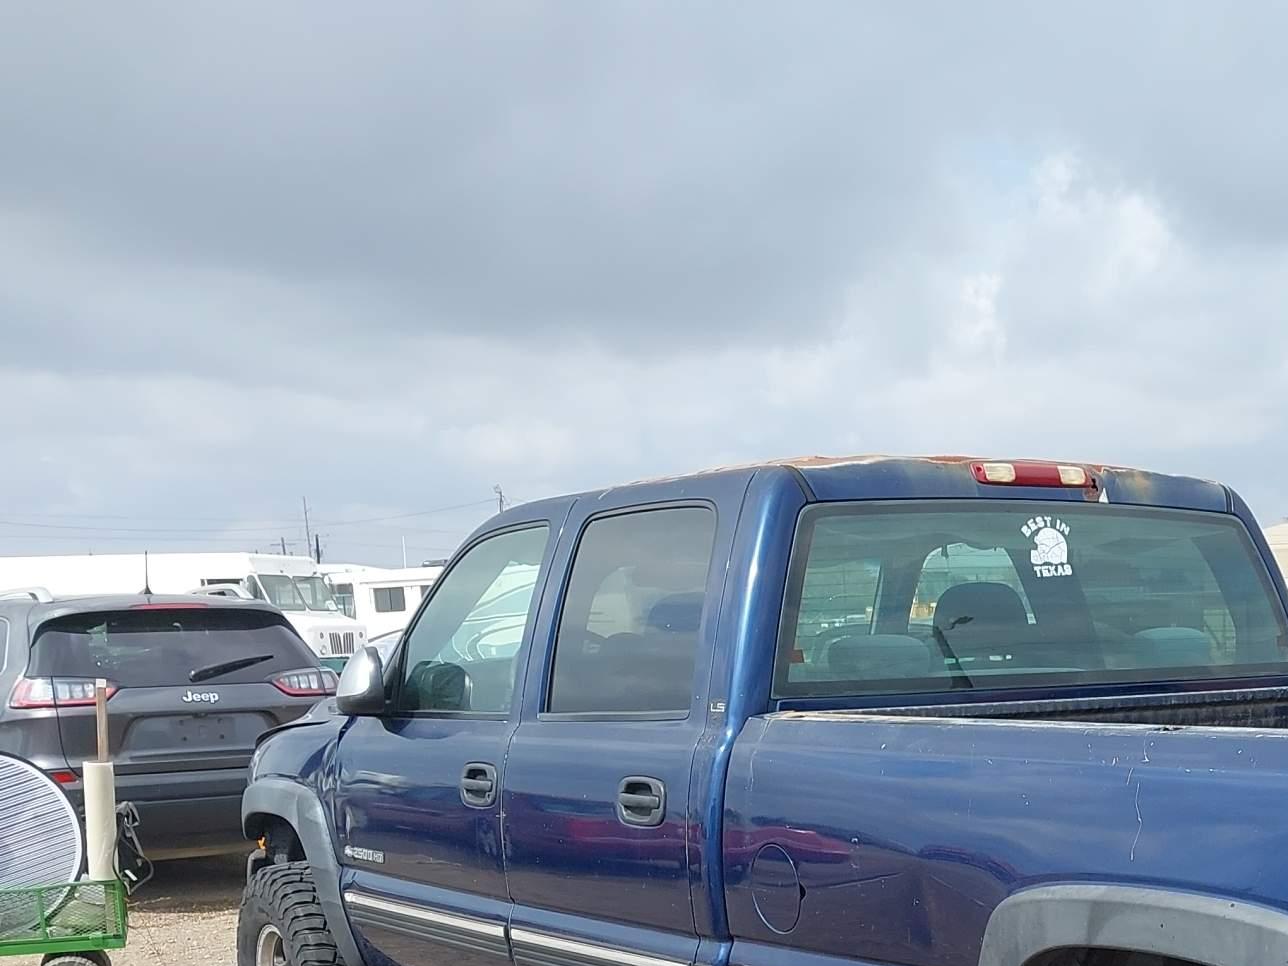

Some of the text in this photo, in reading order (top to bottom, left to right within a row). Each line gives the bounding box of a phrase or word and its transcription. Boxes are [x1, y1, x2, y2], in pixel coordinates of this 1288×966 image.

[1021, 516, 1070, 538] BEST IN
[1033, 564, 1073, 577] TEXAS
[182, 690, 219, 704] Jeep
[710, 702, 726, 713] LS
